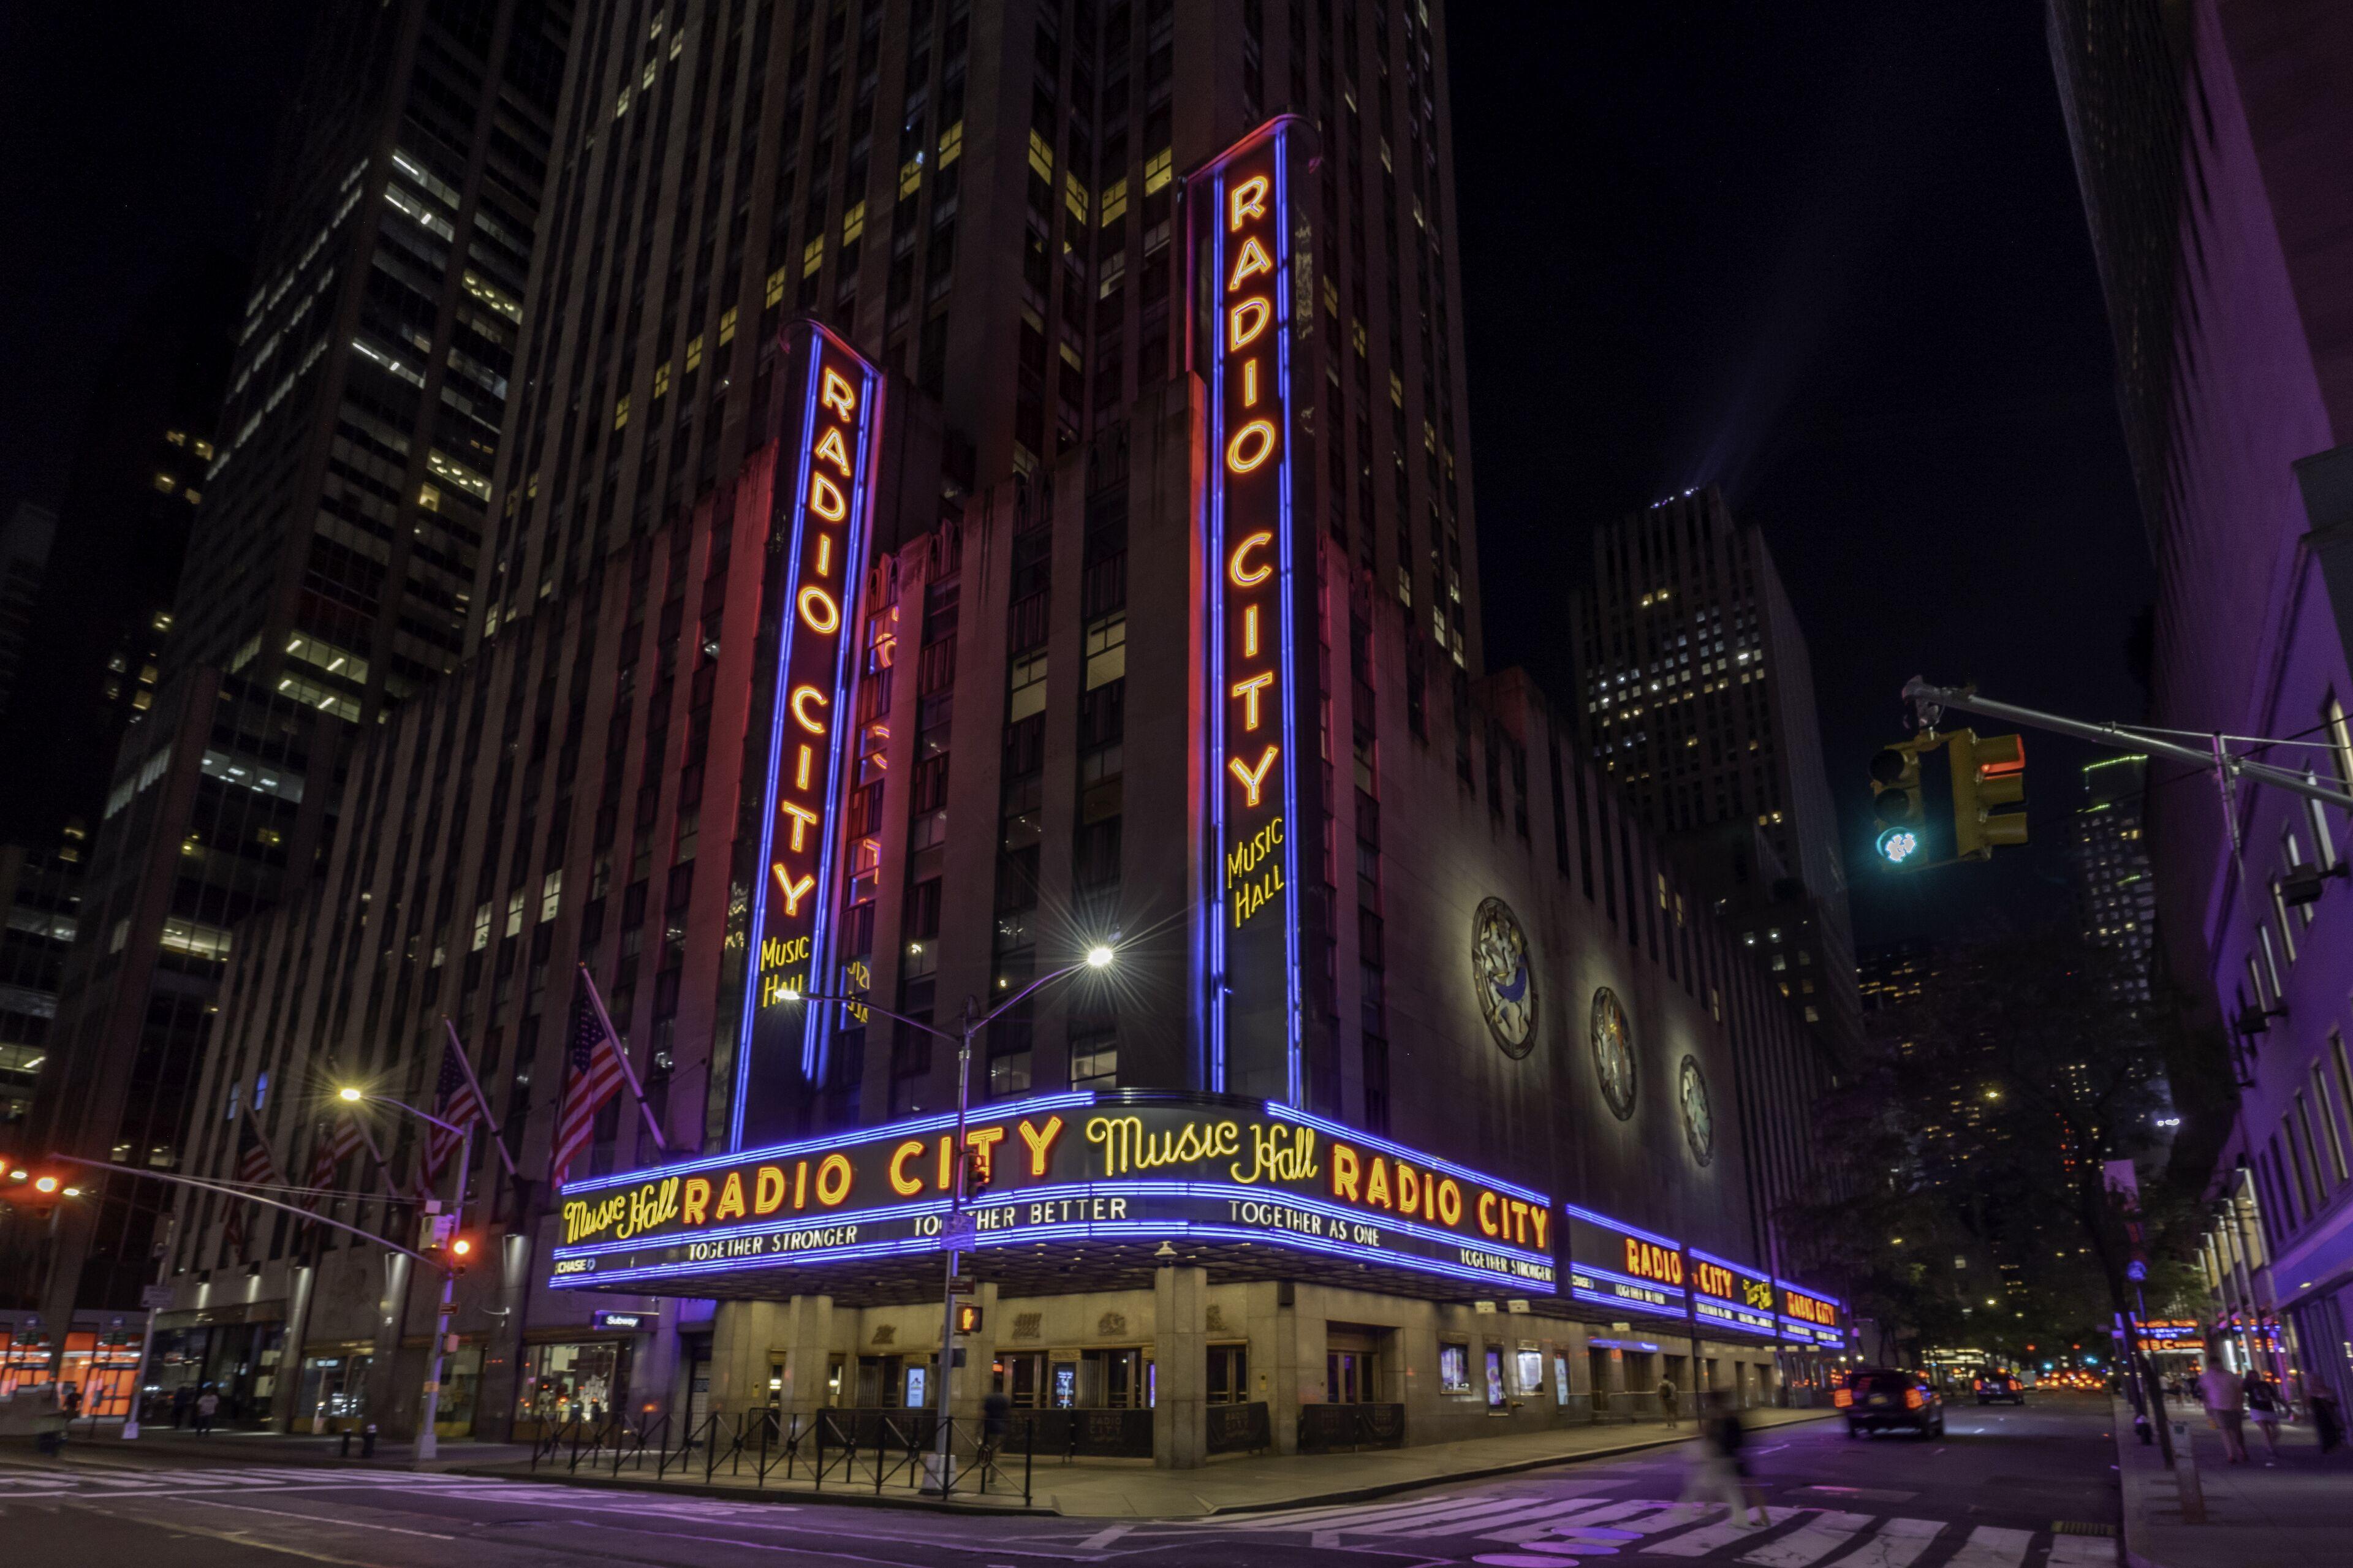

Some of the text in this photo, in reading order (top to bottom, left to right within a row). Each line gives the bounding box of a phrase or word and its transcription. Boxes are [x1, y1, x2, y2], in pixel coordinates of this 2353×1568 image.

[1227, 175, 1279, 808] RADIO CITY
[771, 366, 855, 917] RADIO CITY
[1227, 817, 1284, 890] MUSIC
[1234, 864, 1285, 929] HALL
[760, 936, 810, 972] MUSIC
[683, 1115, 1064, 1225] RADIO CITY
[1086, 1116, 1319, 1184] Music Hall
[563, 1176, 680, 1244] Music Hall
[1029, 1197, 1127, 1225] BETTER
[1332, 1142, 1549, 1249] RADIO CITY
[689, 1225, 857, 1261] TOGETHER STRONGER
[1227, 1200, 1381, 1248] TOGETHER AS ONE
[557, 1258, 587, 1274] CHASE
[1460, 1248, 1552, 1281] TOGETHER STRONGER
[1625, 1237, 1683, 1285] RADIO
[1699, 1261, 1733, 1298] CITY
[605, 1316, 638, 1327] Subway
